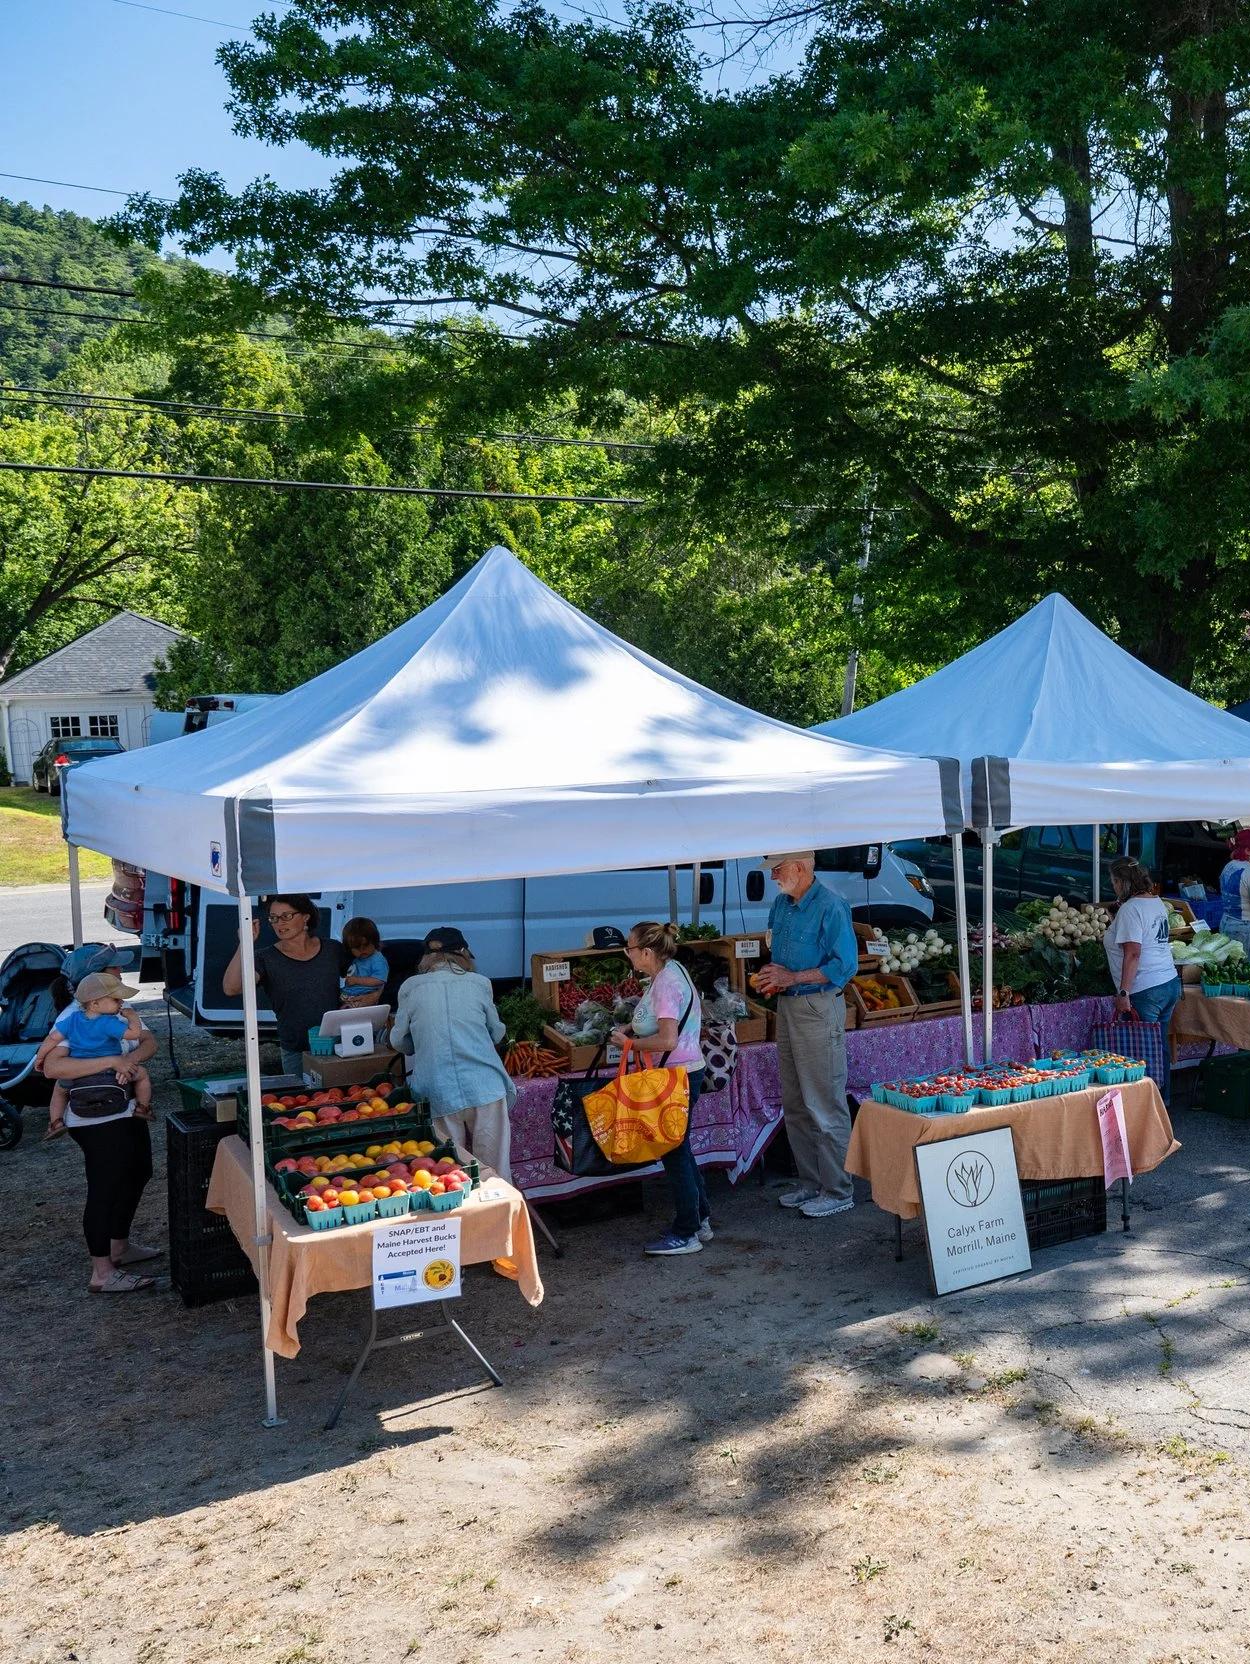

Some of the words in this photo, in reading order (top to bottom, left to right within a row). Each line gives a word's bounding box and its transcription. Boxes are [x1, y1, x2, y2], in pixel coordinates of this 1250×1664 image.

[545, 963, 568, 971] RADISHES
[388, 1225, 430, 1238] SNAP/EBT
[431, 1224, 446, 1232] and
[947, 1224, 976, 1238] Calyx
[978, 1217, 1004, 1231] Farm
[377, 1239, 401, 1249] Maine
[402, 1236, 433, 1246] Harvest
[434, 1233, 457, 1242] Bucks
[946, 1239, 984, 1257] Morrill,
[985, 1232, 1017, 1247] Maine
[387, 1247, 424, 1258] Accepted
[425, 1244, 446, 1253] Here!
